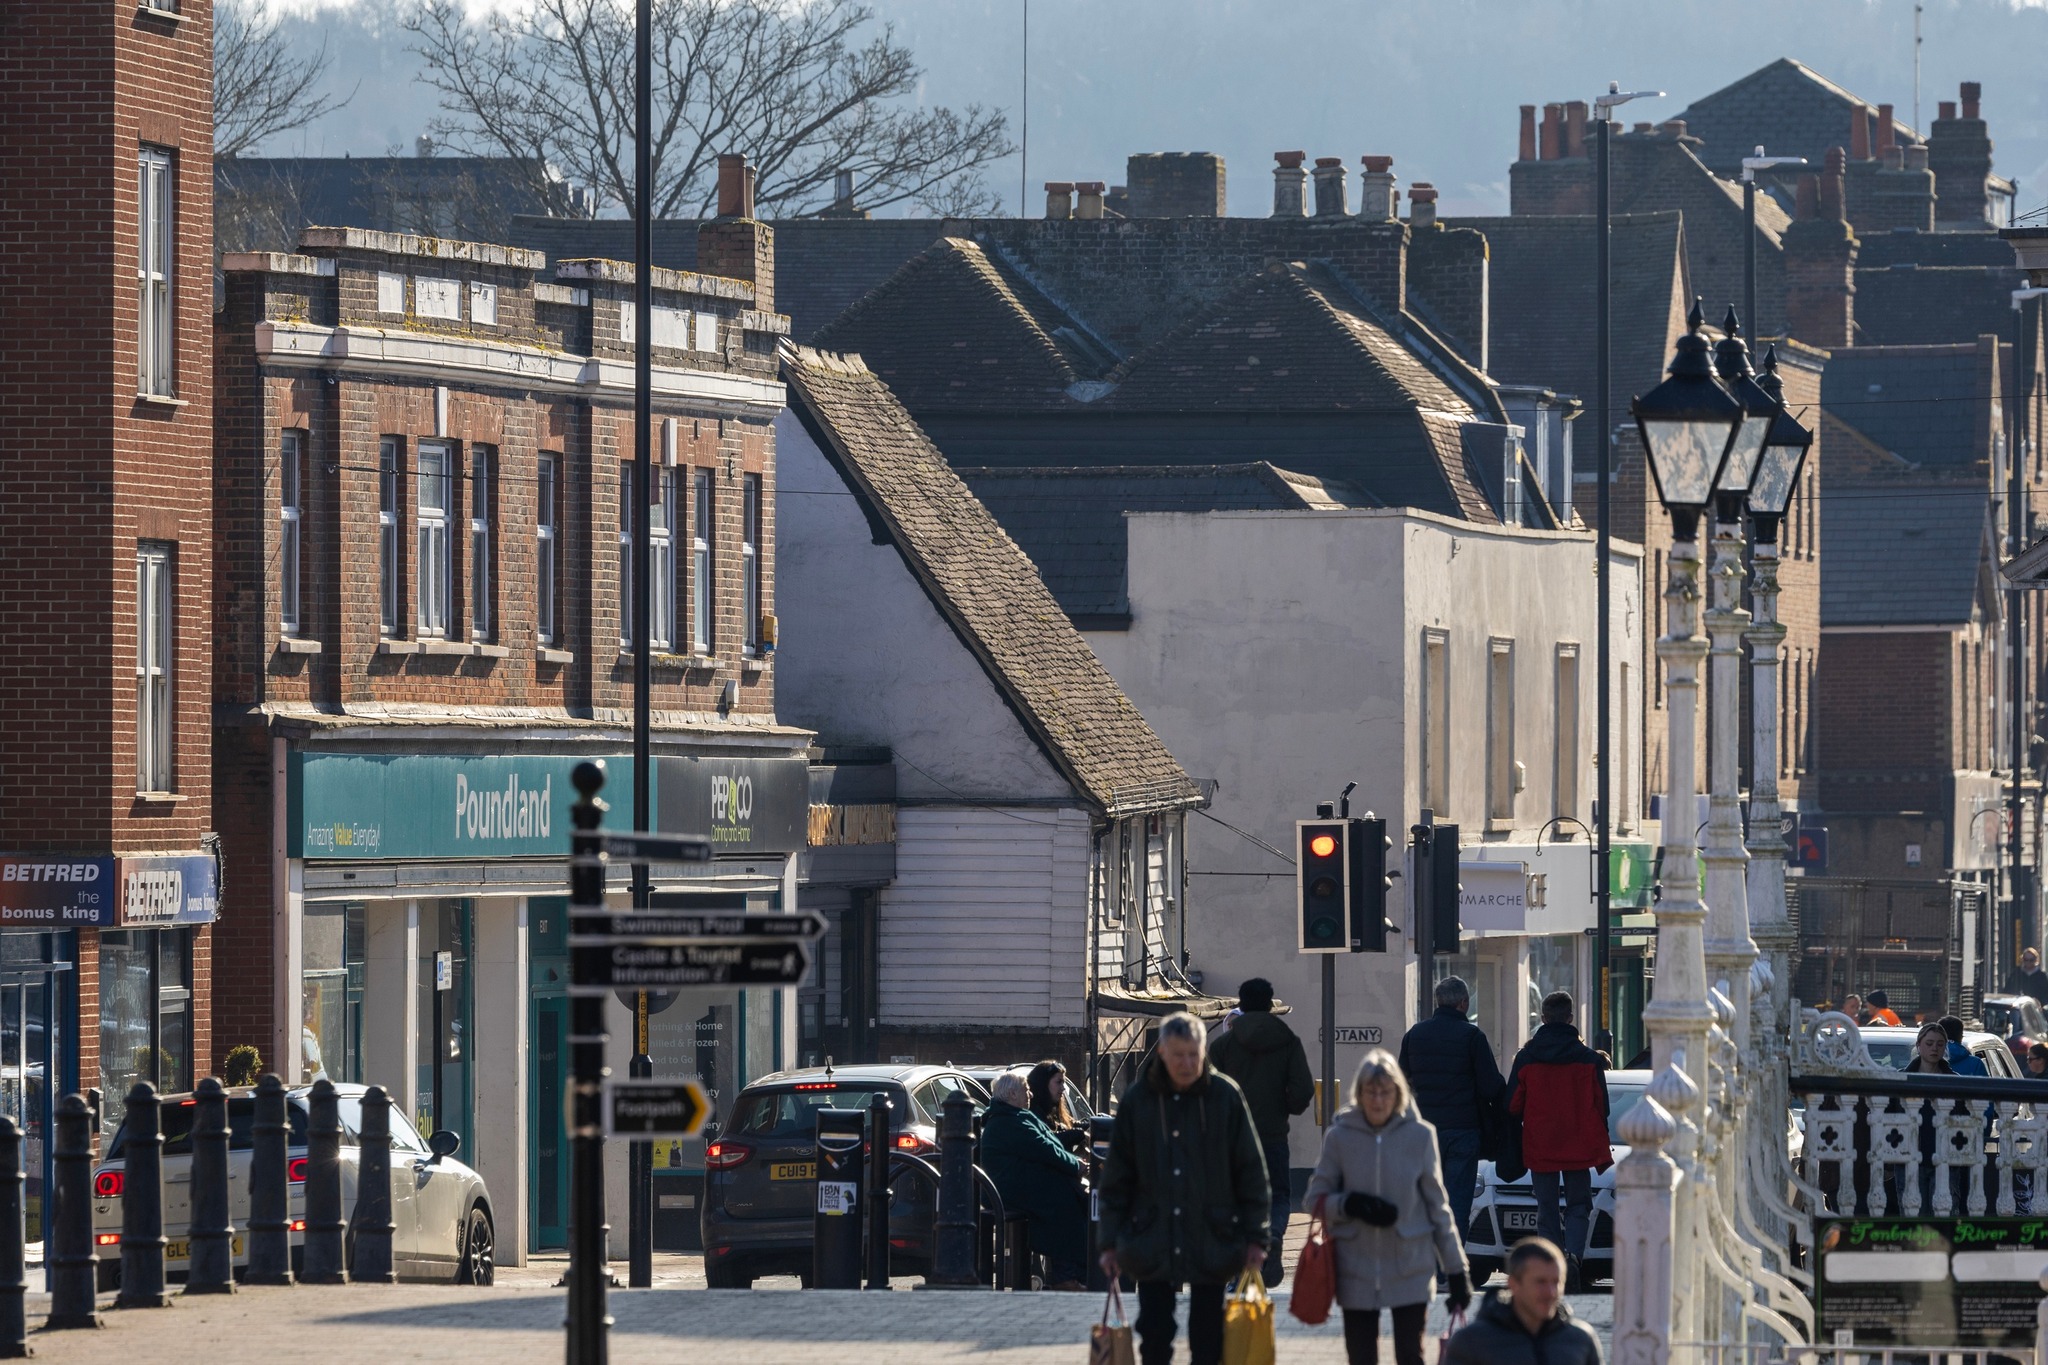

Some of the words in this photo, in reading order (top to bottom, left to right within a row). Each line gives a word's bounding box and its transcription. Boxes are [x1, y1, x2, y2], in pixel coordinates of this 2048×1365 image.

[456, 773, 551, 839] Poundland
[307, 822, 334, 852] Amazing
[333, 822, 353, 846] Value
[353, 822, 380, 853] Everyday!
[2, 864, 100, 881] BETFRED
[77, 890, 100, 904] the
[127, 870, 182, 917] BETFRED
[1459, 894, 1522, 906] MARCHE
[187, 892, 203, 912] bonus
[203, 892, 216, 914] king
[2, 905, 55, 919] bonus
[62, 905, 100, 922] king
[702, 916, 745, 934] Pool
[1632, 926, 1653, 935] Centre
[650, 1022, 683, 1032] othing
[695, 1021, 723, 1031] Home
[1335, 1029, 1378, 1041] TANY
[650, 1038, 676, 1048] illed
[687, 1039, 719, 1047] Frozen
[654, 1056, 667, 1064] od
[669, 1056, 679, 1064] to
[680, 1055, 694, 1064] Go
[678, 1072, 704, 1081] Drink
[778, 1165, 807, 1177] CU19
[1510, 1213, 1537, 1227] EY6
[1850, 1222, 1940, 1246] Tonbridge
[1953, 1221, 2008, 1243] River
[166, 1242, 190, 1258] GL
